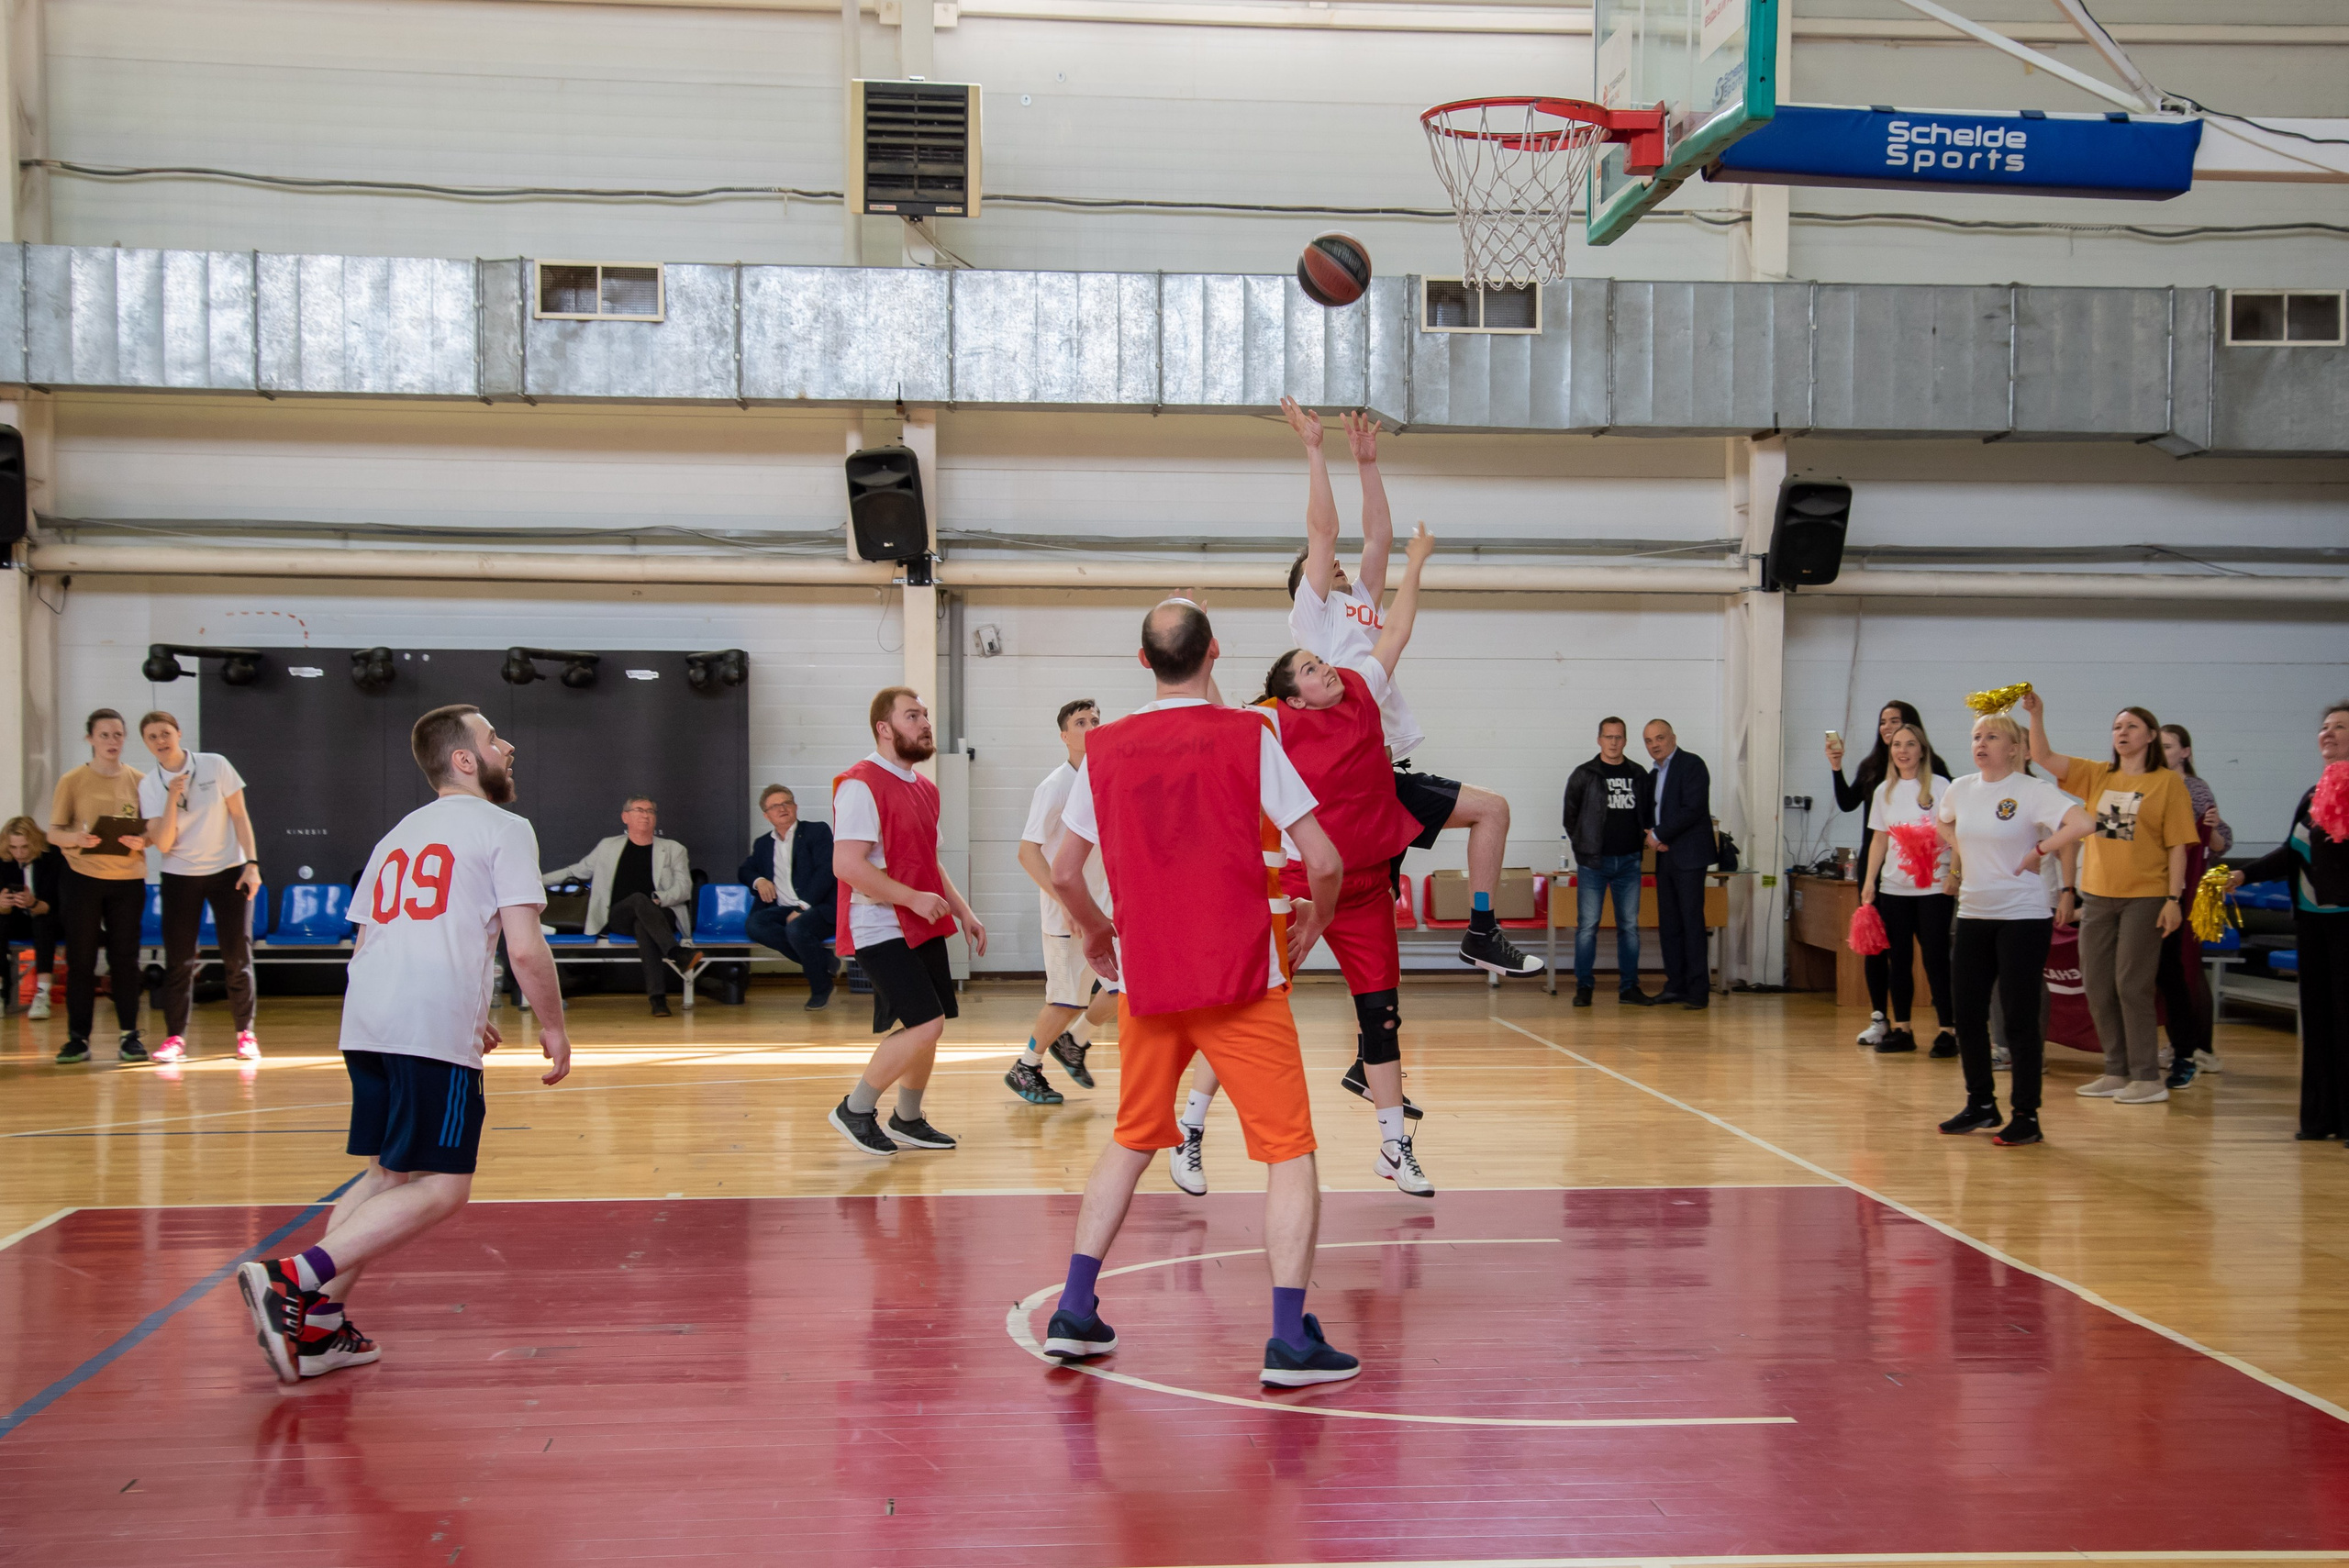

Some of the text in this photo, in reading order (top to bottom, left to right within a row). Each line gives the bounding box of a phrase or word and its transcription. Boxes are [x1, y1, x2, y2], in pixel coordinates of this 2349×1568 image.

[1887, 121, 2027, 149] Schelde
[1886, 143, 2025, 172] Sports
[372, 843, 455, 924] 09
